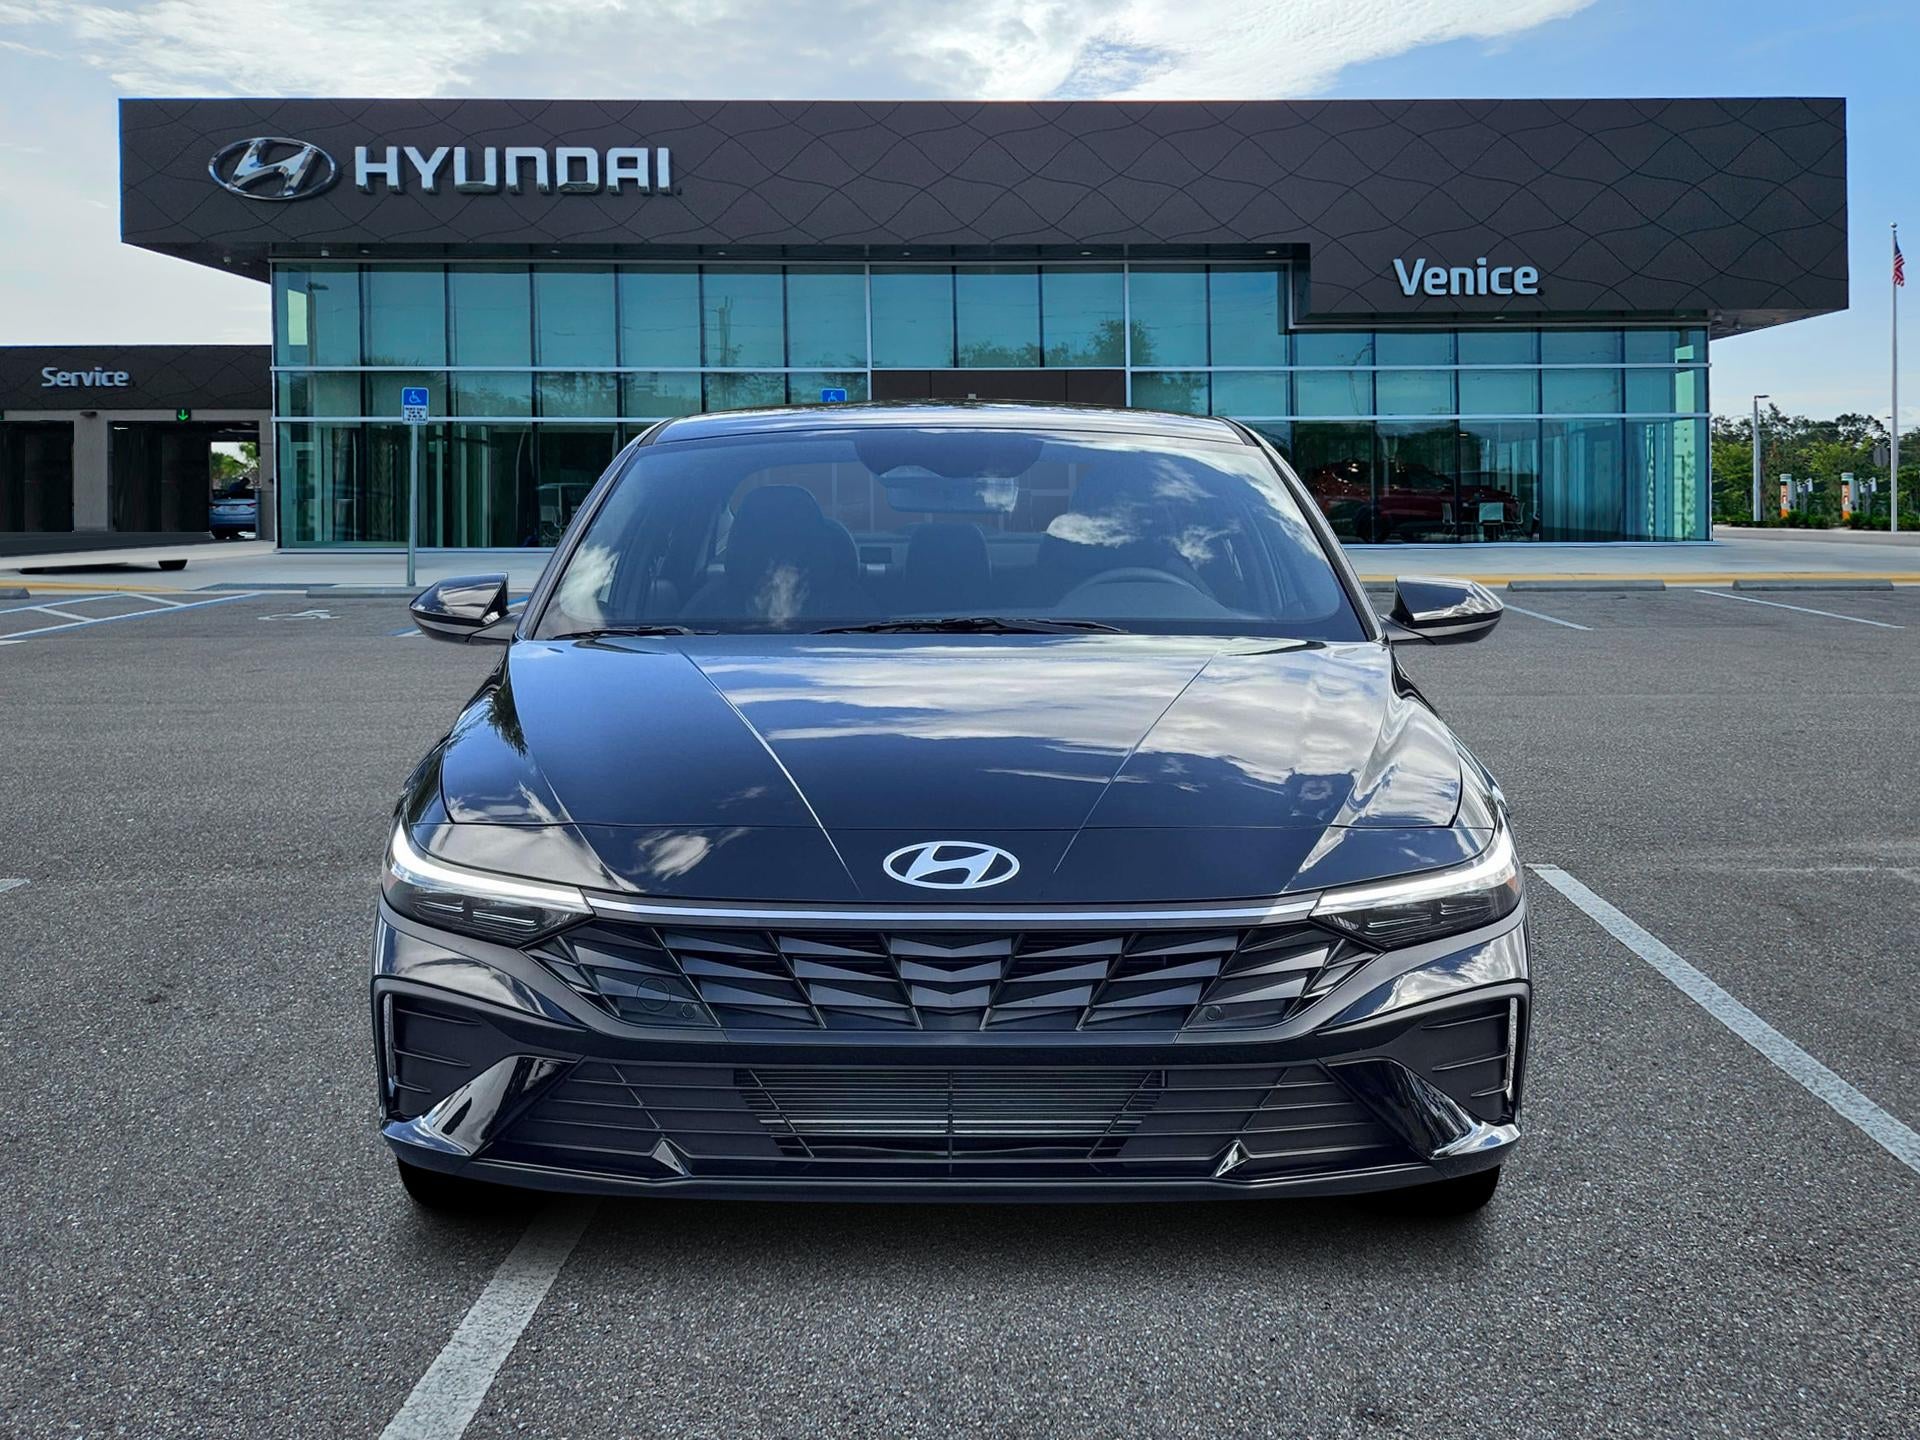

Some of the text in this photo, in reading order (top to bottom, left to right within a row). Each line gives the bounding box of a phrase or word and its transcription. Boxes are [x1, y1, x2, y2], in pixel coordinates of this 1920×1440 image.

[354, 146, 672, 194] HYUNDAI
[1392, 256, 1539, 296] Venice
[41, 366, 130, 387] Service
